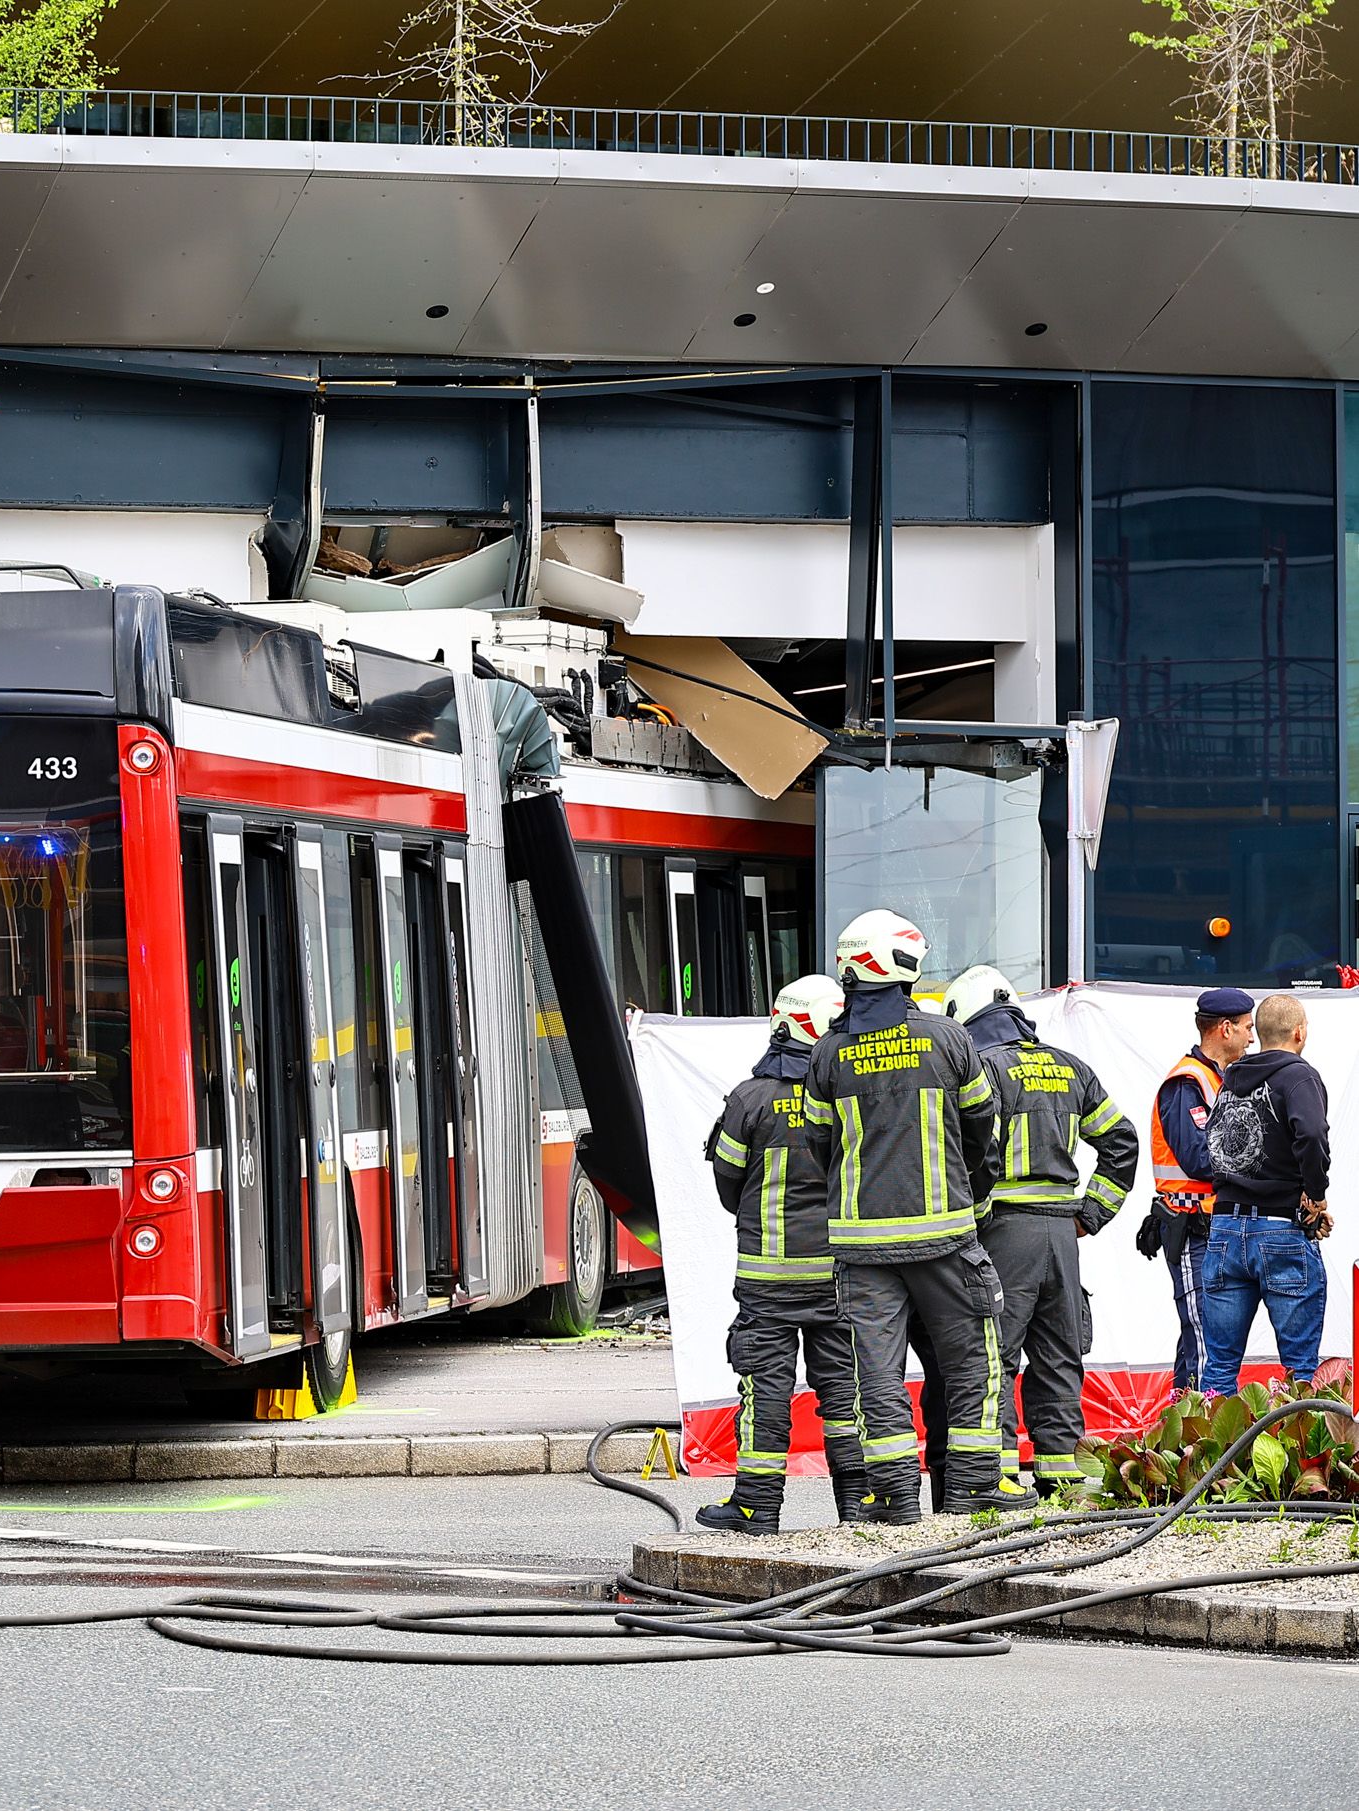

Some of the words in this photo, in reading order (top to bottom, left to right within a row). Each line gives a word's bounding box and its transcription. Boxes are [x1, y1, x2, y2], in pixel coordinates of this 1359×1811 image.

[27, 756, 78, 780] 433
[838, 1038, 933, 1063] FEUERWEHR
[853, 1053, 920, 1075] SALZBURG
